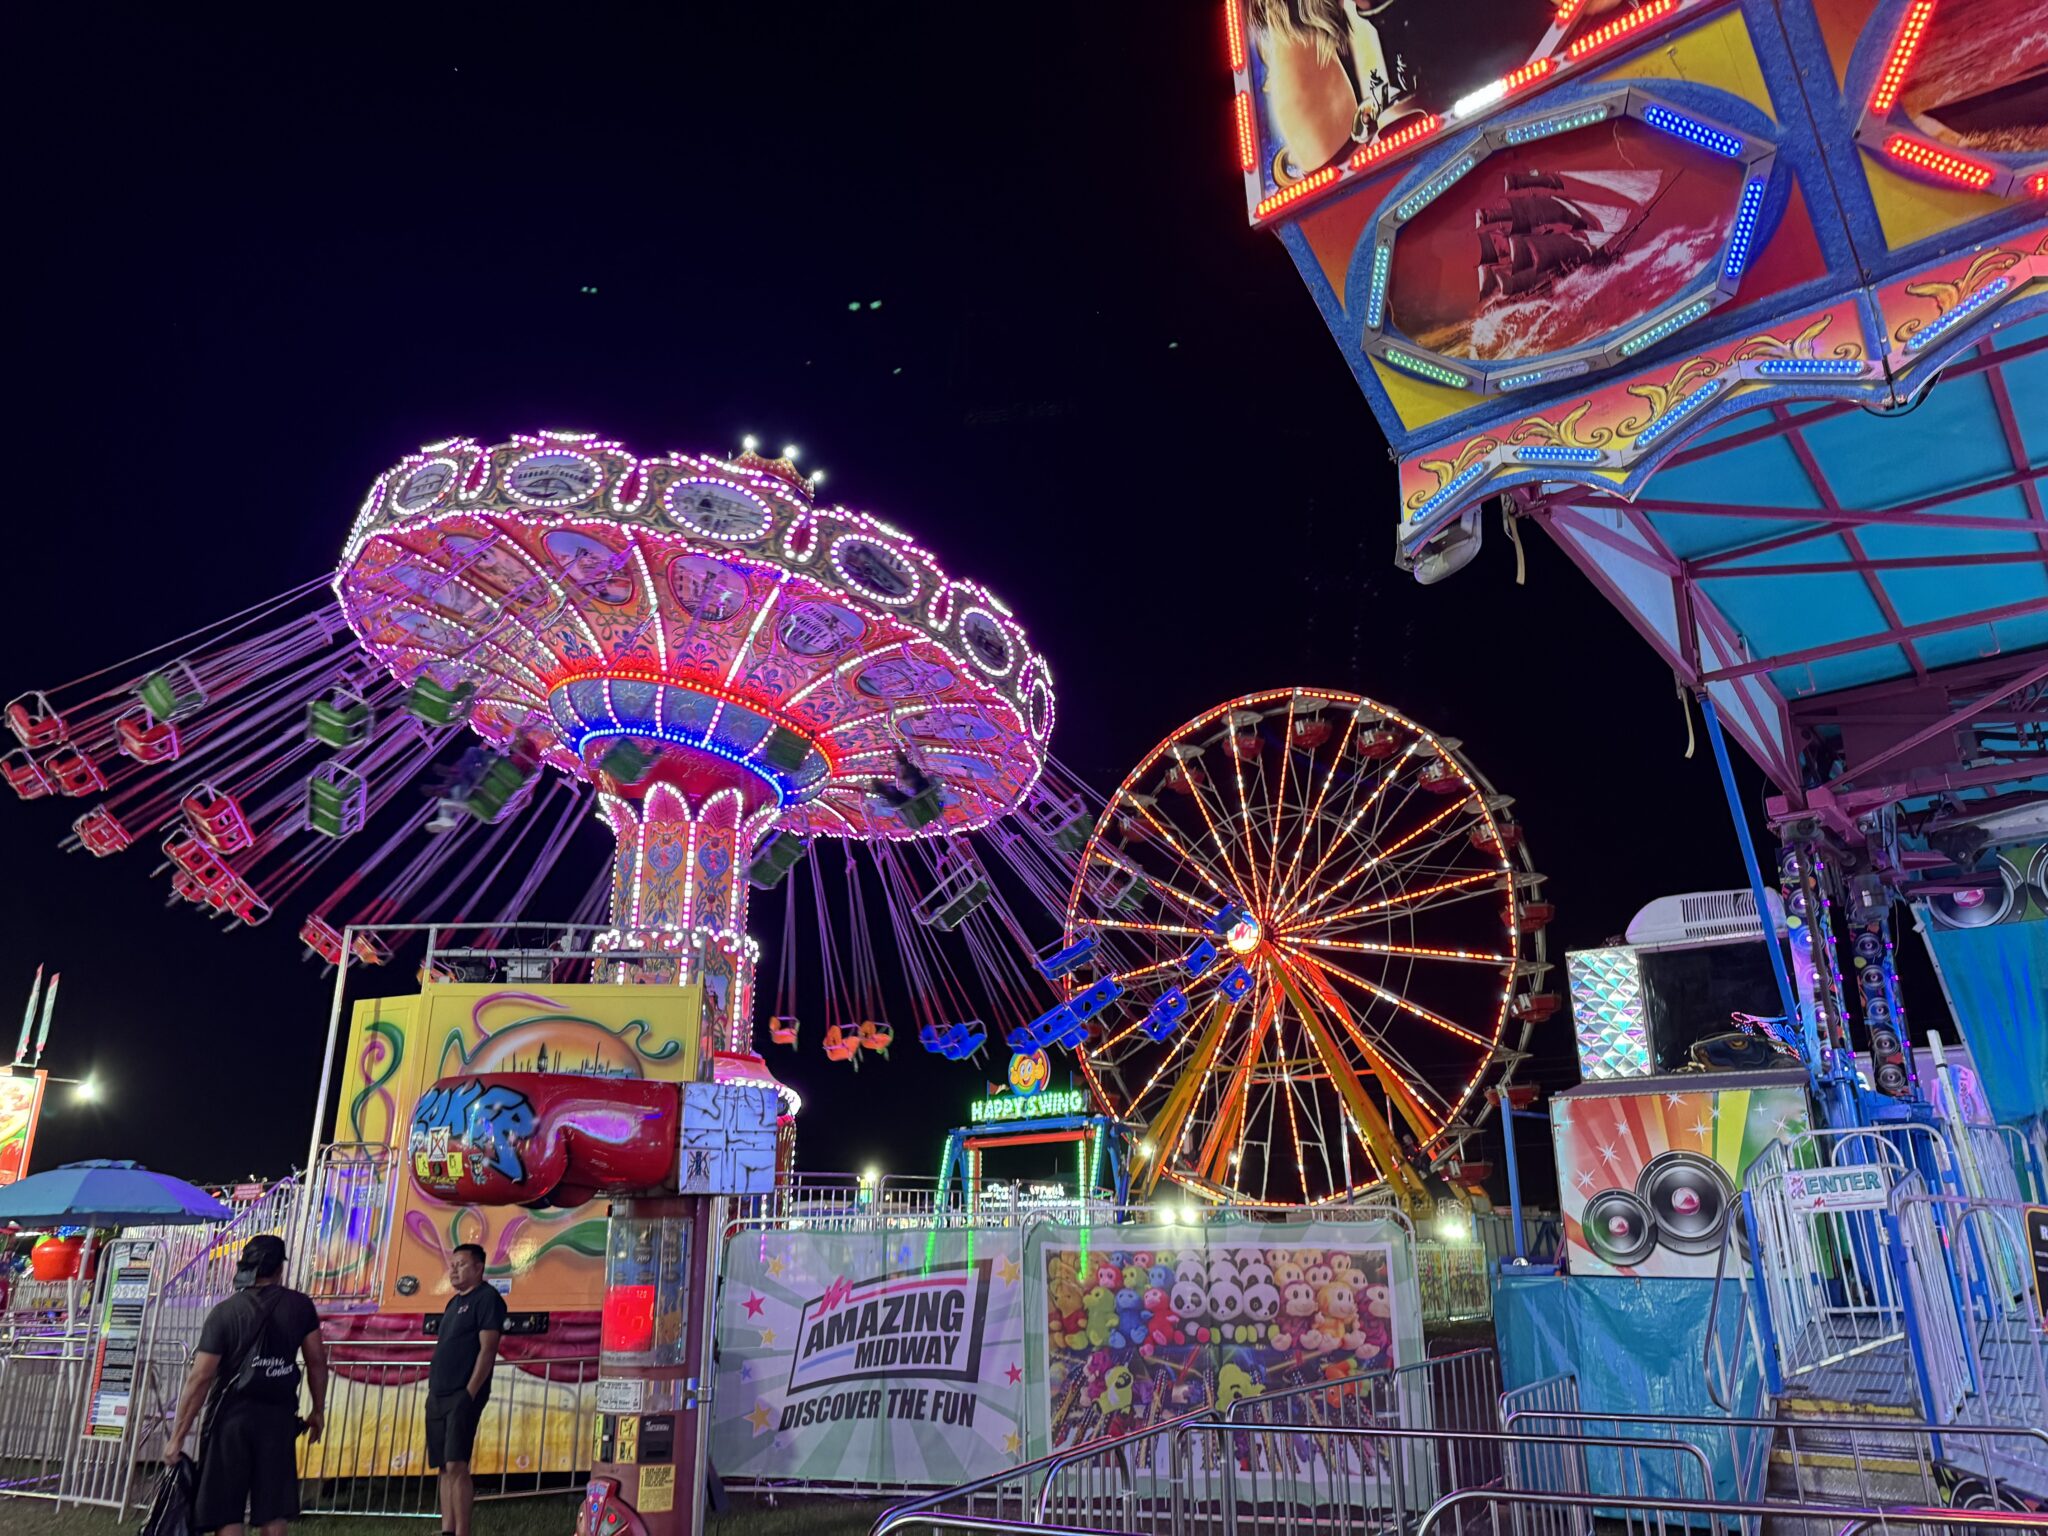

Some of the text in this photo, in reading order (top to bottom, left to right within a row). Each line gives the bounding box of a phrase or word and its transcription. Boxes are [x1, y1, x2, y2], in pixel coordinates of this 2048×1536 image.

[971, 1090, 1082, 1122] HAPPY SWING
[1803, 1171, 1881, 1195] ENTER
[802, 1289, 966, 1360] AMAZING
[853, 1335, 961, 1370] MIDWAY
[778, 1388, 977, 1433] DISCOVER THE FUN
